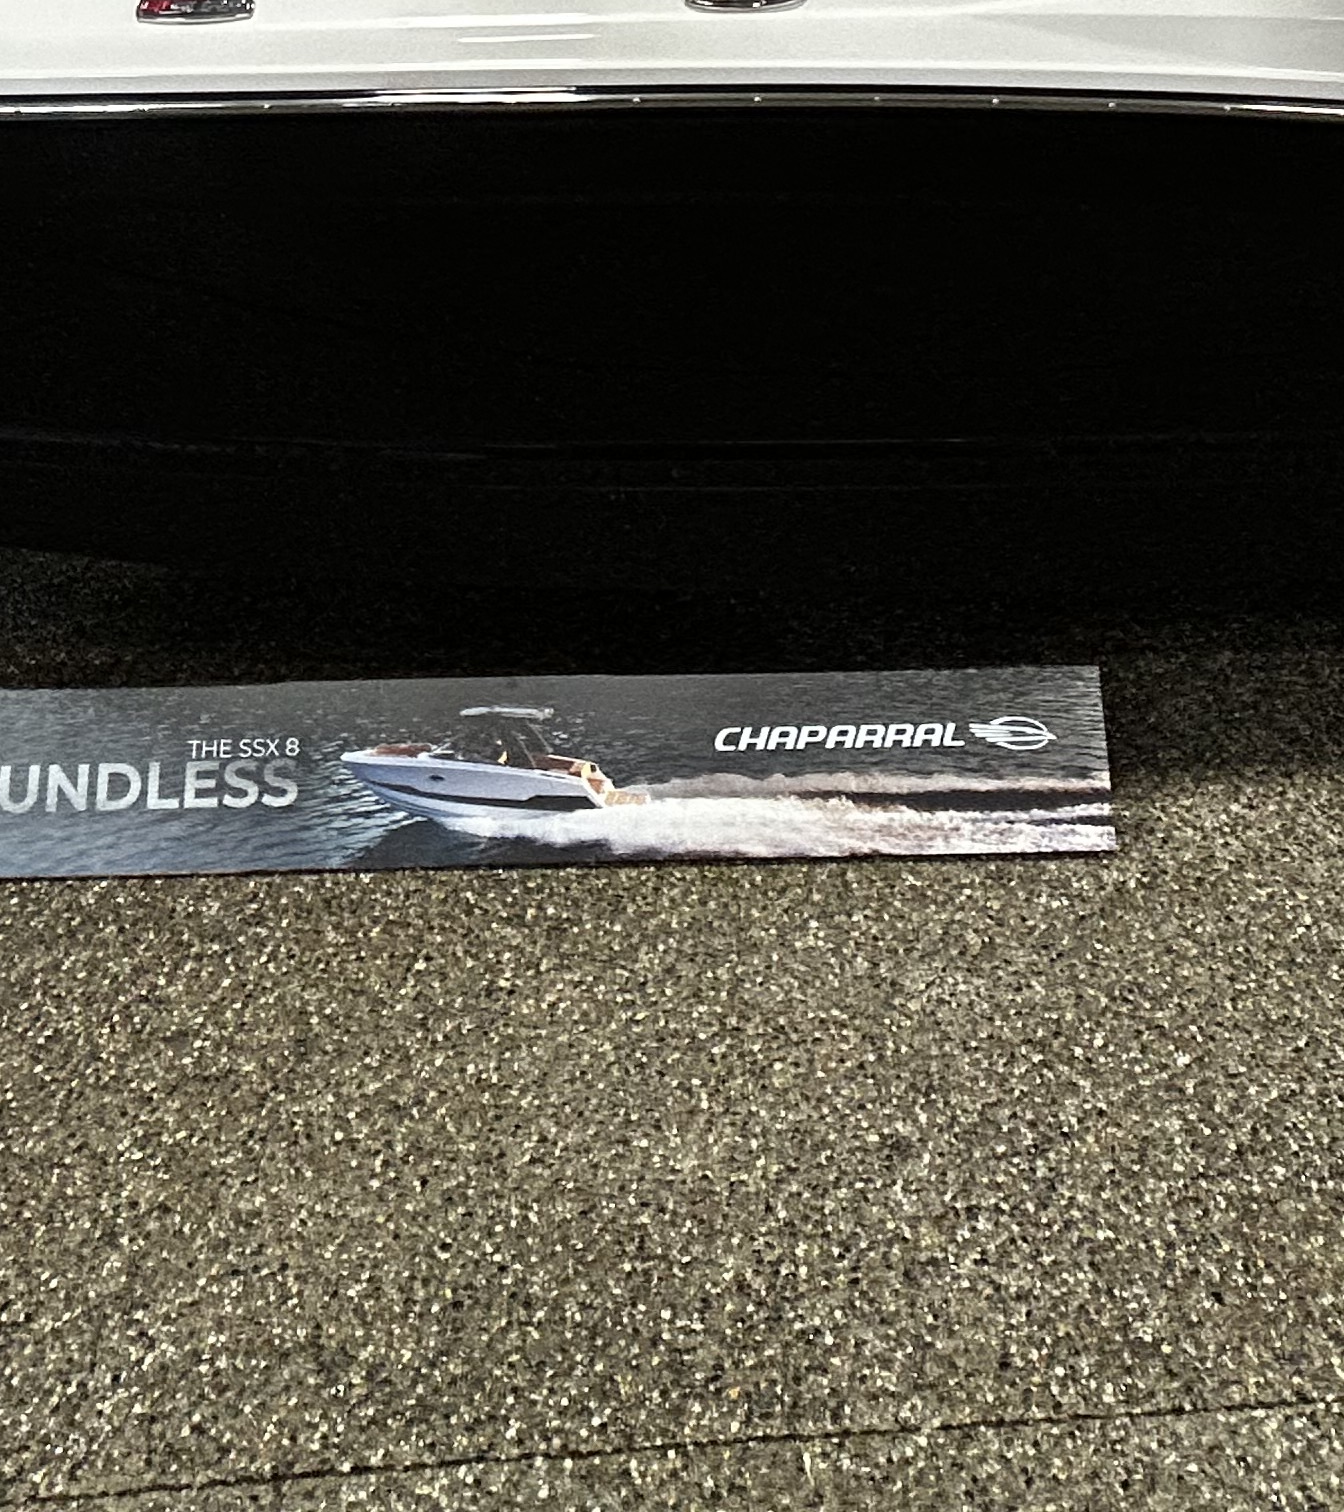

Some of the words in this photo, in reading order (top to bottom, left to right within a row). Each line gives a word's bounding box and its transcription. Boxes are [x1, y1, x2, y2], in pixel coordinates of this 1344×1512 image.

[188, 739, 233, 759] THE
[238, 738, 280, 758] SSX
[286, 737, 301, 757] 8
[714, 722, 966, 753] CHAPARRAL
